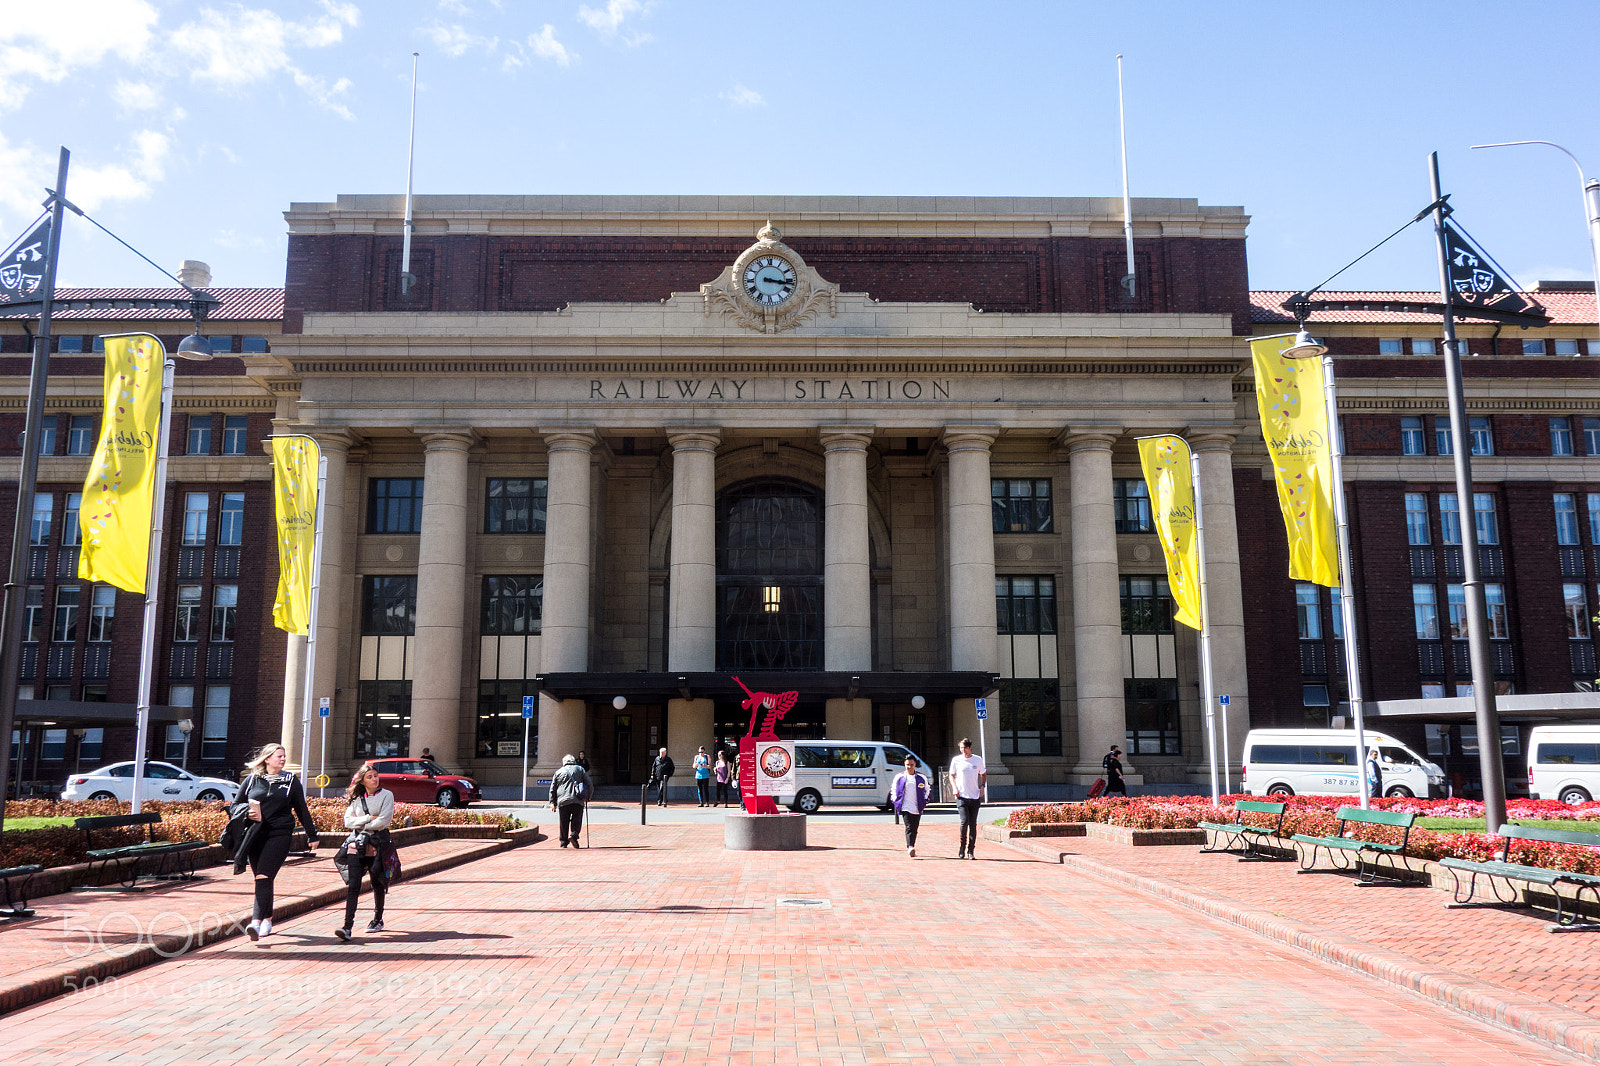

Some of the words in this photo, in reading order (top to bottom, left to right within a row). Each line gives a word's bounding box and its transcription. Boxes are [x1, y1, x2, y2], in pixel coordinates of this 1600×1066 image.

[590, 379, 748, 400] RAILWAY
[795, 379, 951, 400] STATION
[832, 777, 876, 785] HIREACE
